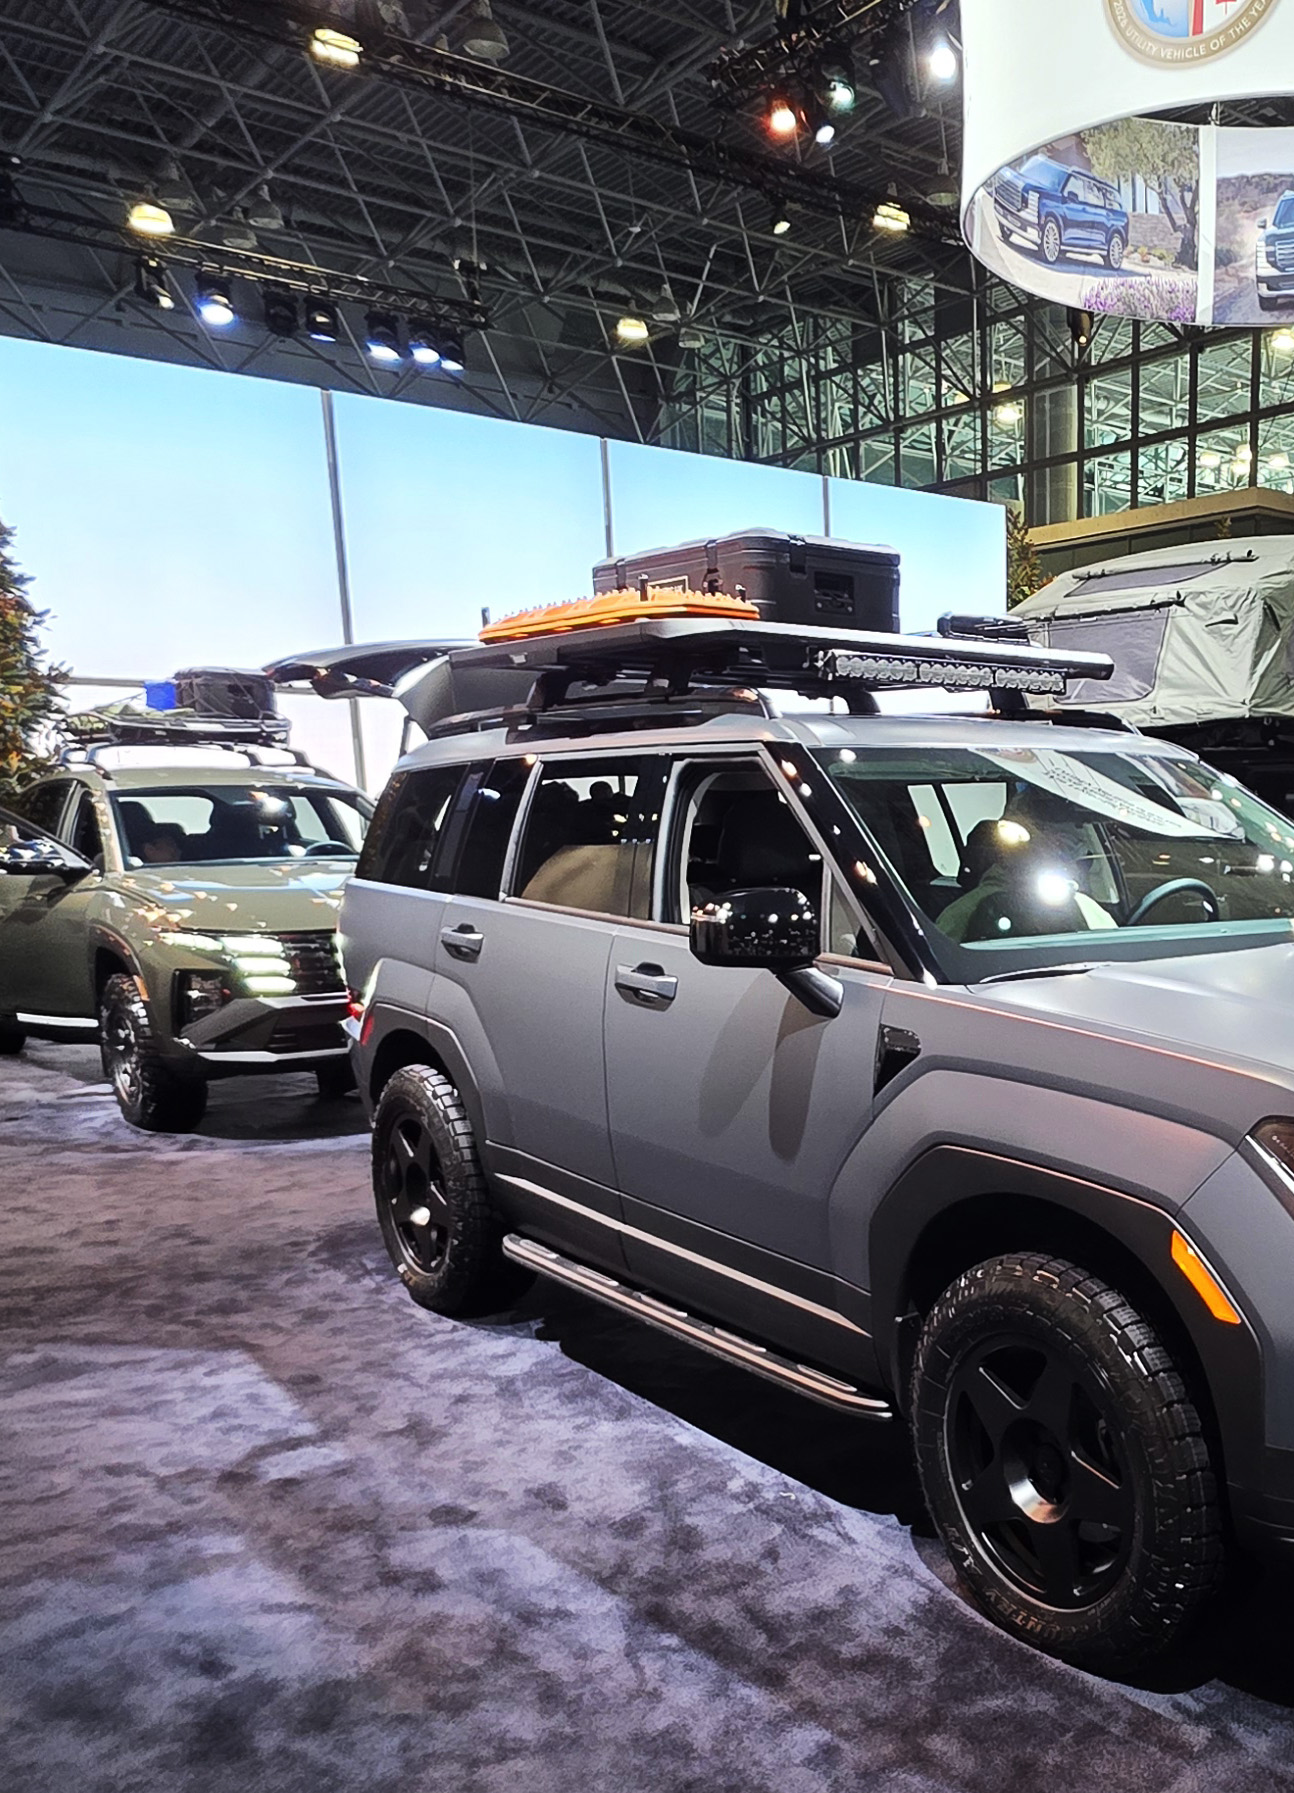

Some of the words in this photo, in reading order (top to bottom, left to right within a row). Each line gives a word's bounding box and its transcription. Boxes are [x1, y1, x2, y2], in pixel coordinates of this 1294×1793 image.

[1113, 1, 1128, 29] 2026
[1126, 27, 1159, 54] UTILITY
[1160, 44, 1206, 61] VEHICLE
[1210, 36, 1226, 50] OF
[1229, 16, 1251, 39] THE
[1249, 0, 1267, 17] YE
